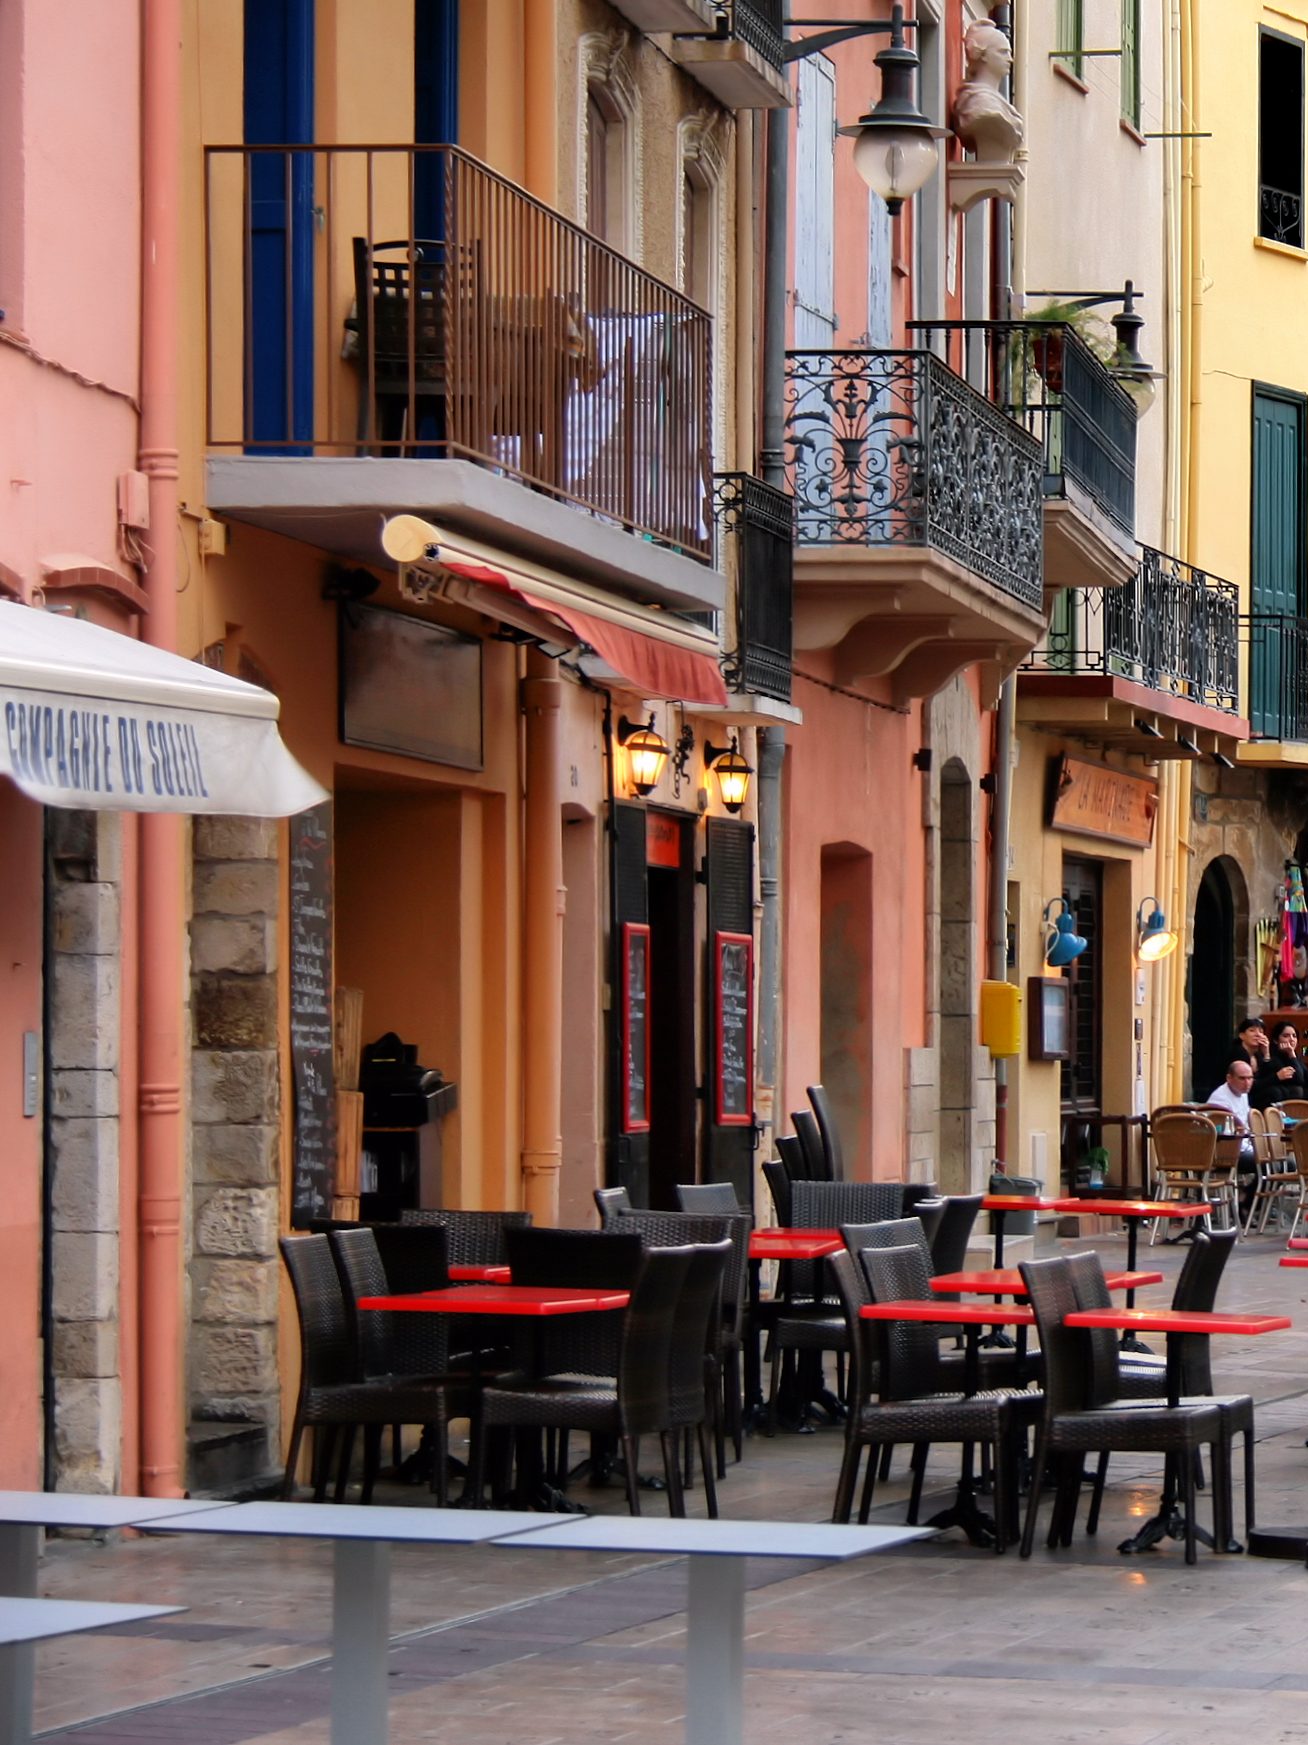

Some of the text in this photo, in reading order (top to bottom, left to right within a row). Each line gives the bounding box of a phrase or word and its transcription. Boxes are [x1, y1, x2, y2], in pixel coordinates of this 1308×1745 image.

[5, 701, 209, 798] COMPAGNIE DU SOLEIL
